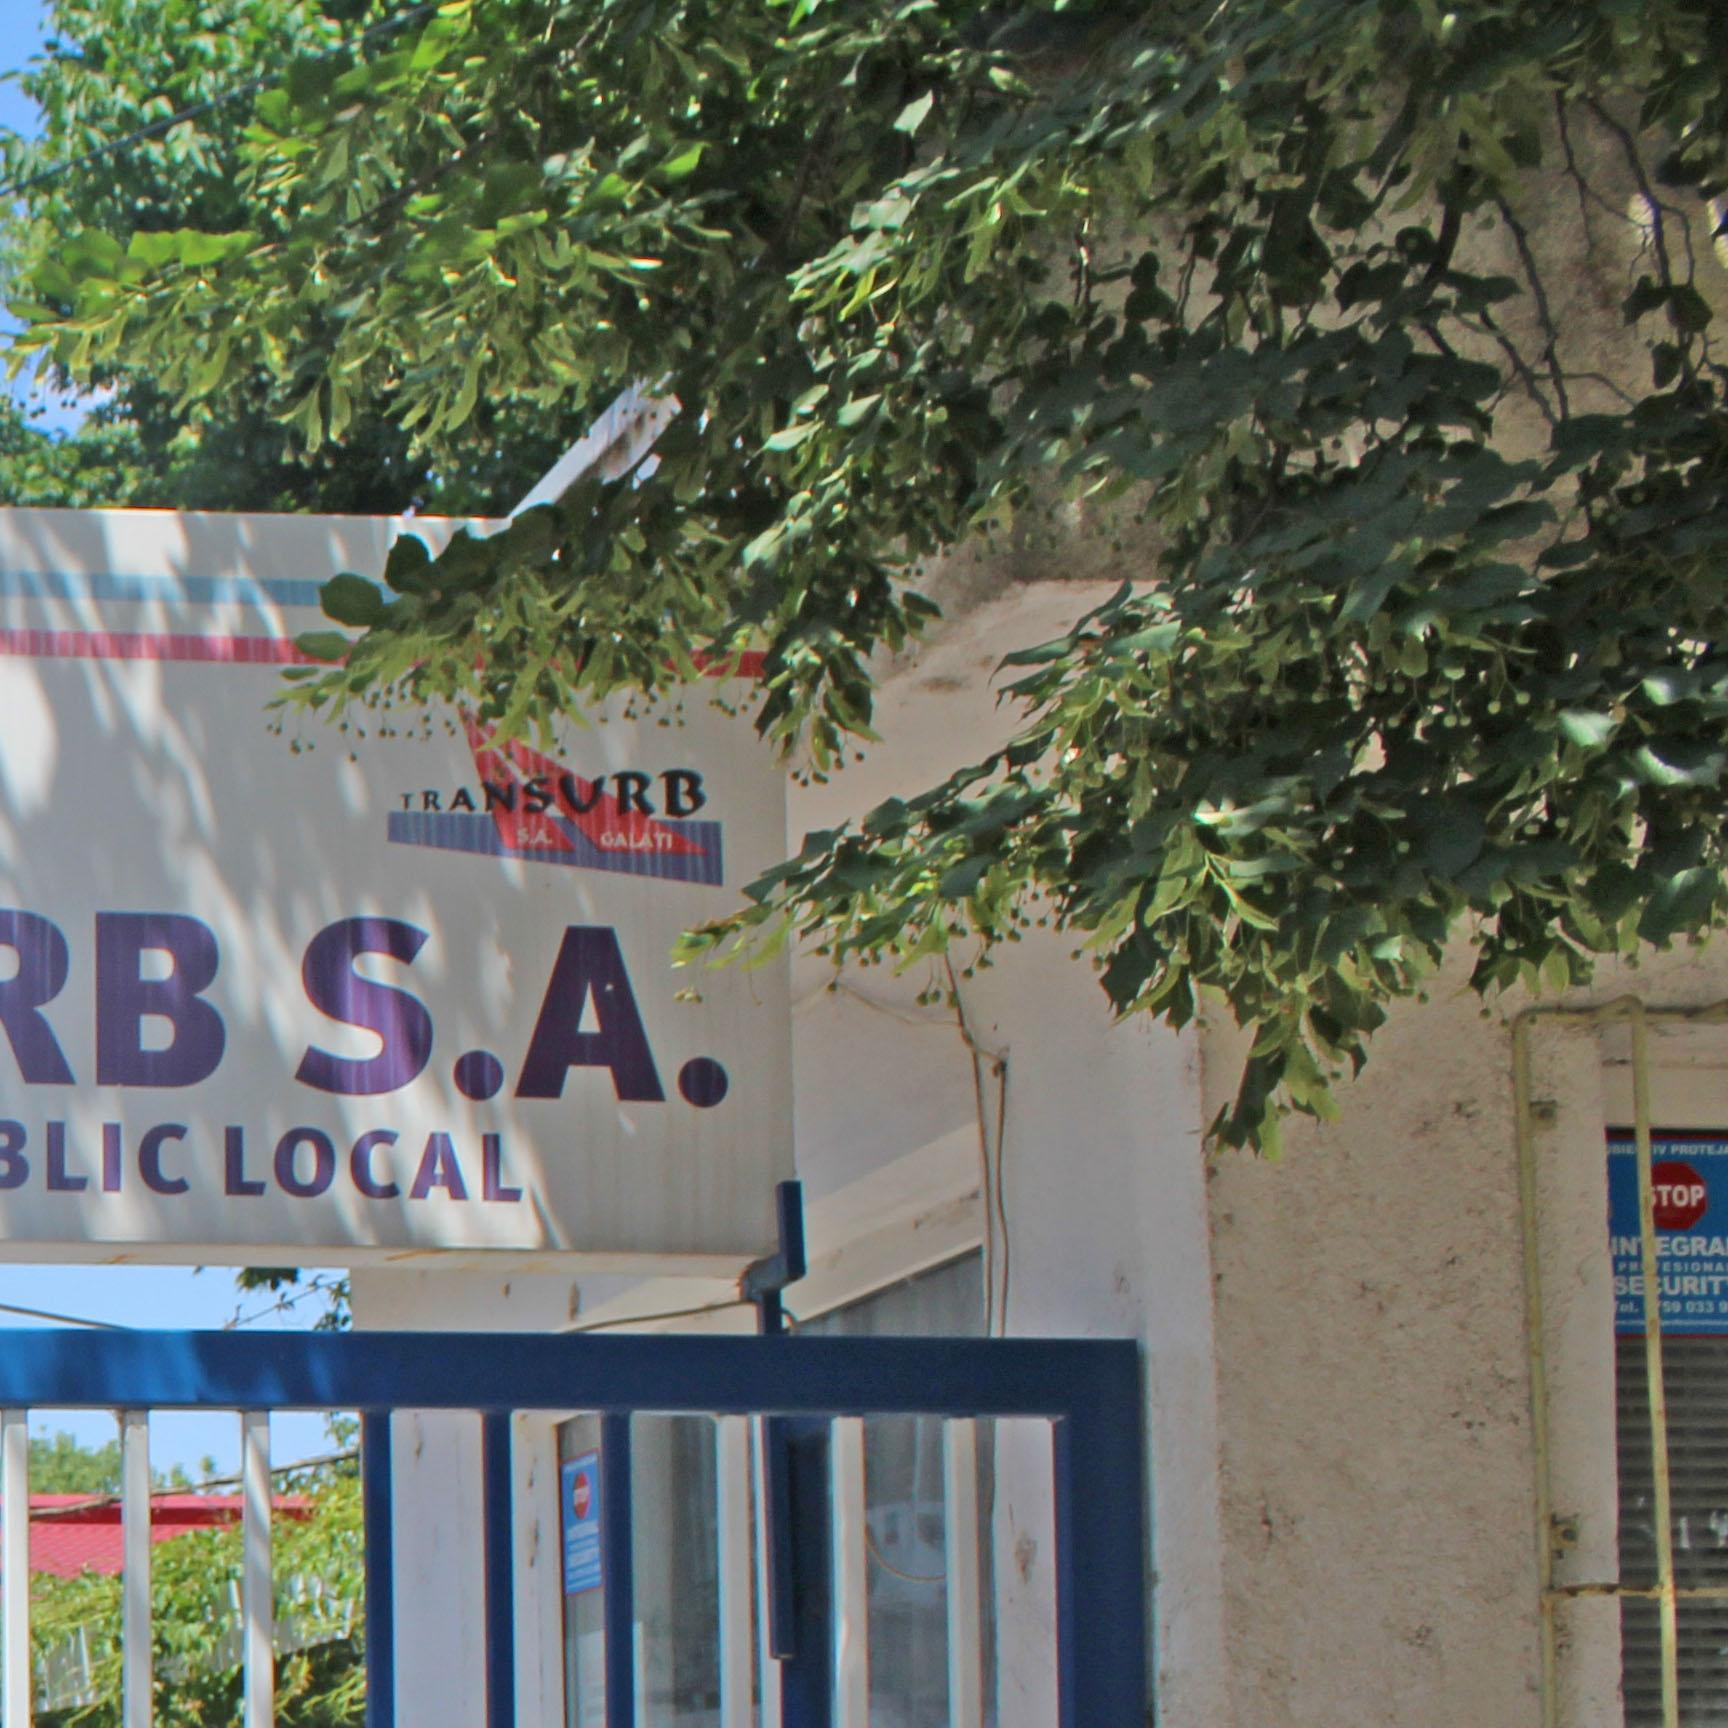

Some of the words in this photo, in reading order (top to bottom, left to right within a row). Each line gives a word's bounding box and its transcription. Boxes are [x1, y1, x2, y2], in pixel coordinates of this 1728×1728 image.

[400, 768, 708, 819] TRANSURB
[516, 827, 553, 845] S.A.
[295, 917, 729, 1108] S.A.
[225, 1124, 523, 1203] LOCAL
